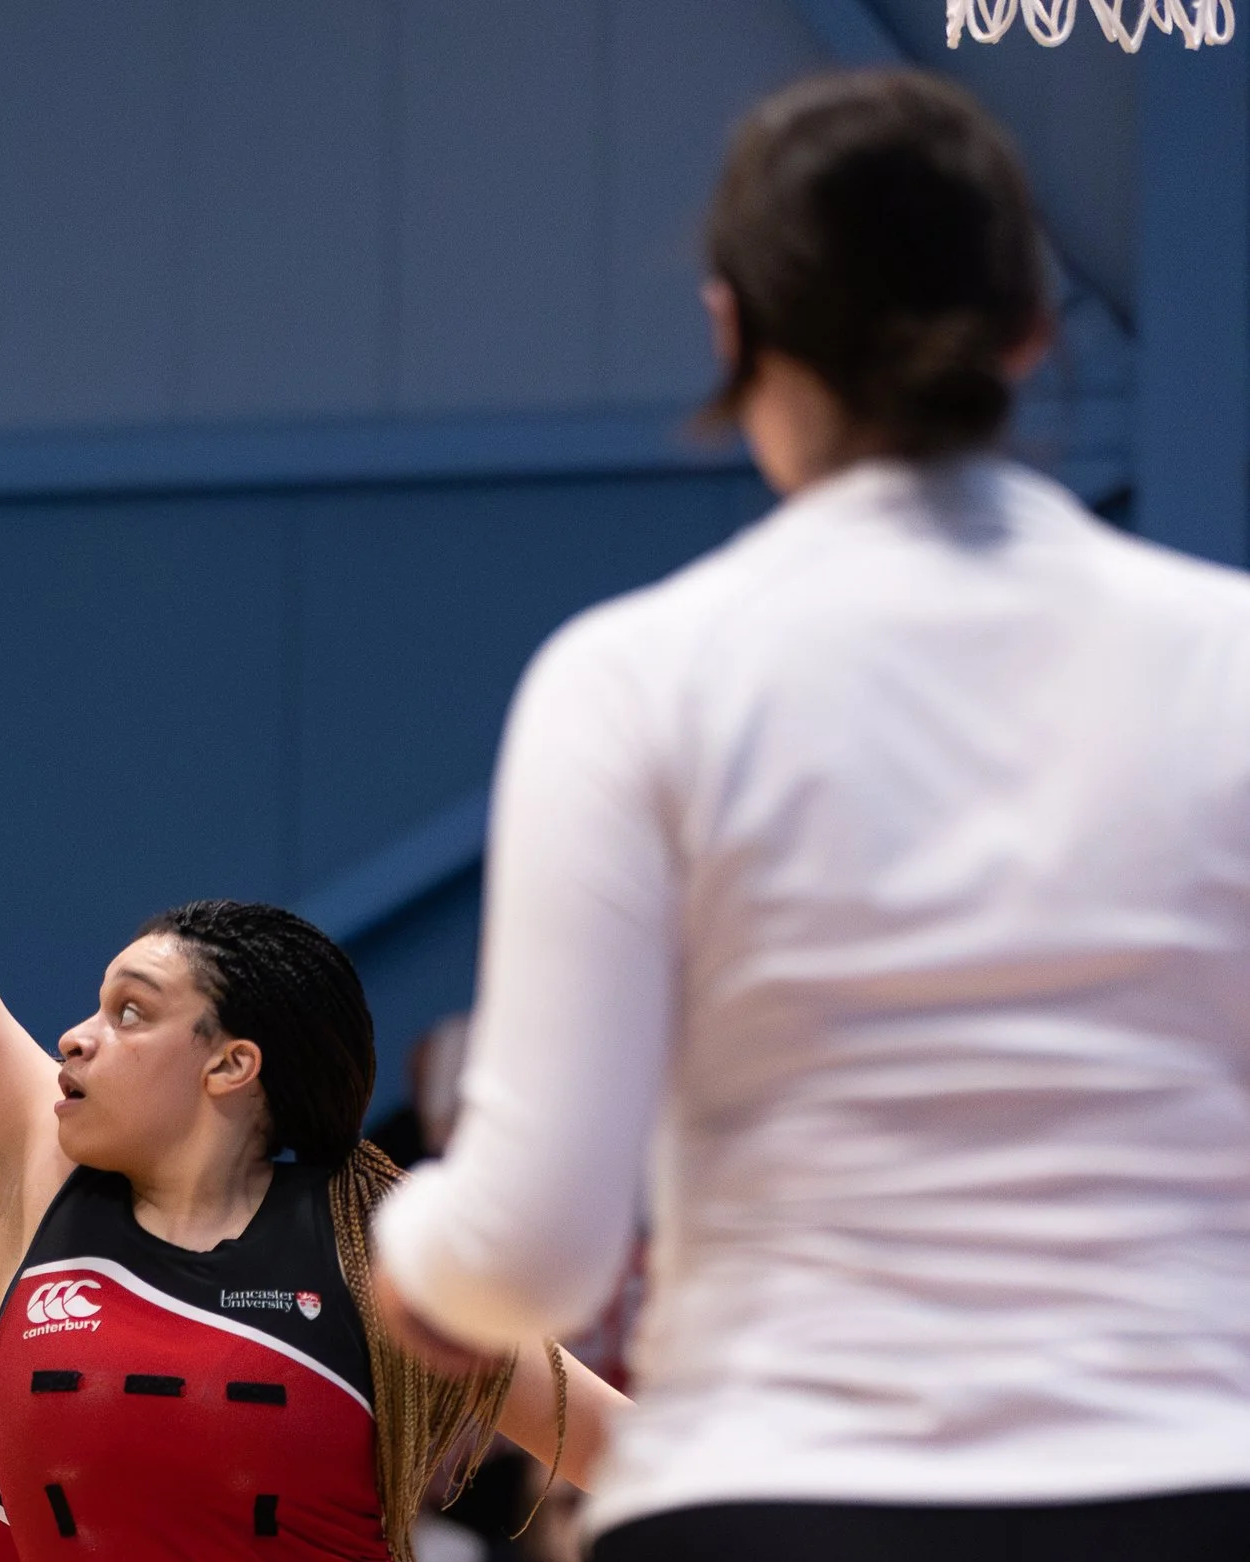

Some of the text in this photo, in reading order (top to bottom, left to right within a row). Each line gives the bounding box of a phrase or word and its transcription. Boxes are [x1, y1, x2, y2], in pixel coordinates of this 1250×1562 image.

[220, 1289, 295, 1301] Lancaster
[220, 1299, 294, 1313] University
[22, 1319, 103, 1340] canterbury
